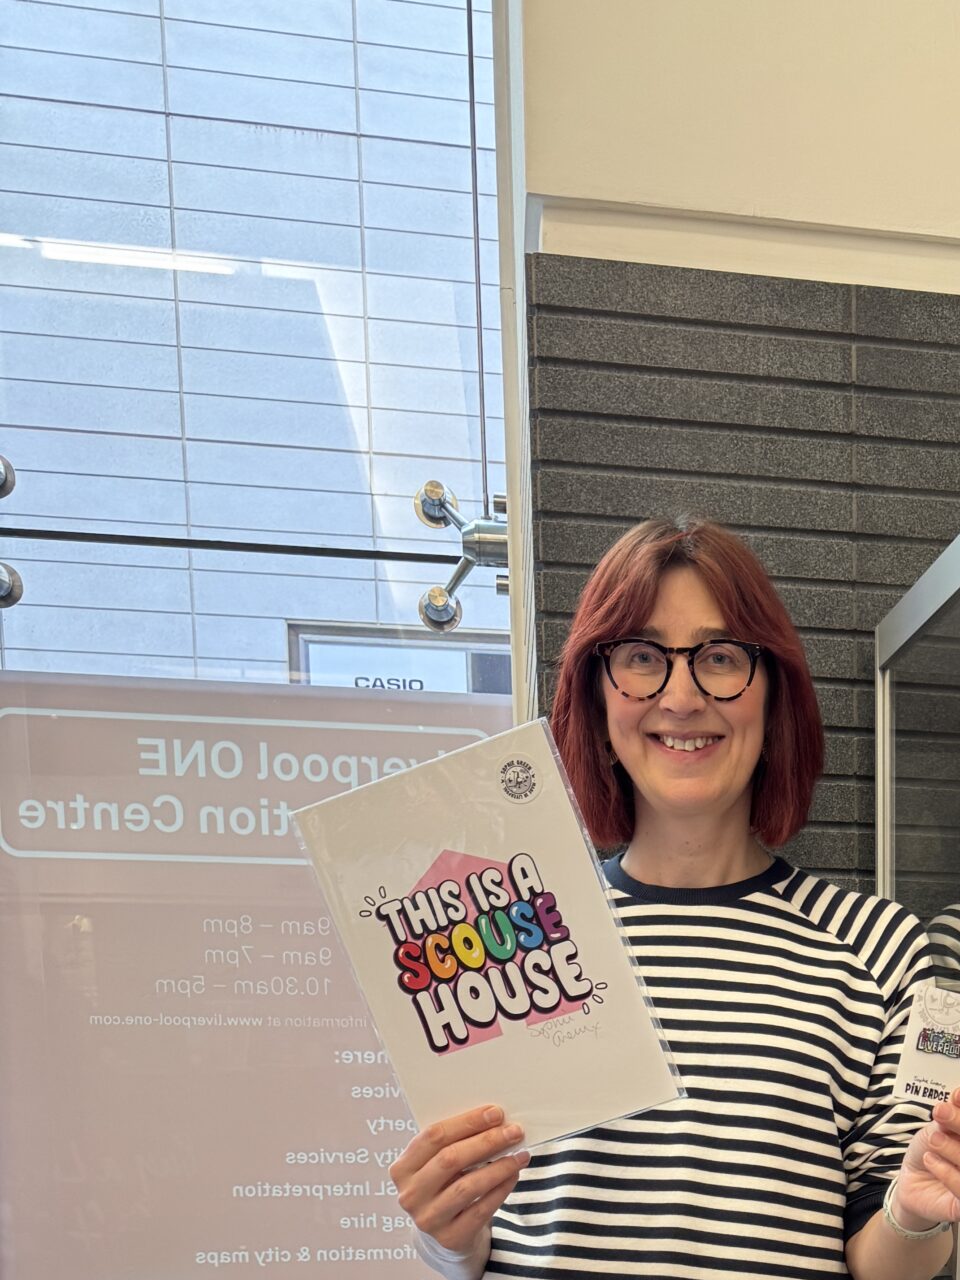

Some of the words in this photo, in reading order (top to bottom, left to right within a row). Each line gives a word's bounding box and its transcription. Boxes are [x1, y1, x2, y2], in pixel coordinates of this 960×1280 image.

[354, 676, 424, 691] CASIO
[376, 880, 467, 943] THIS
[465, 866, 512, 913] IS
[507, 852, 545, 902] A
[394, 891, 571, 994] SCOUSE
[411, 939, 593, 1053] HOUSE
[921, 1087, 951, 1103] BADGE
